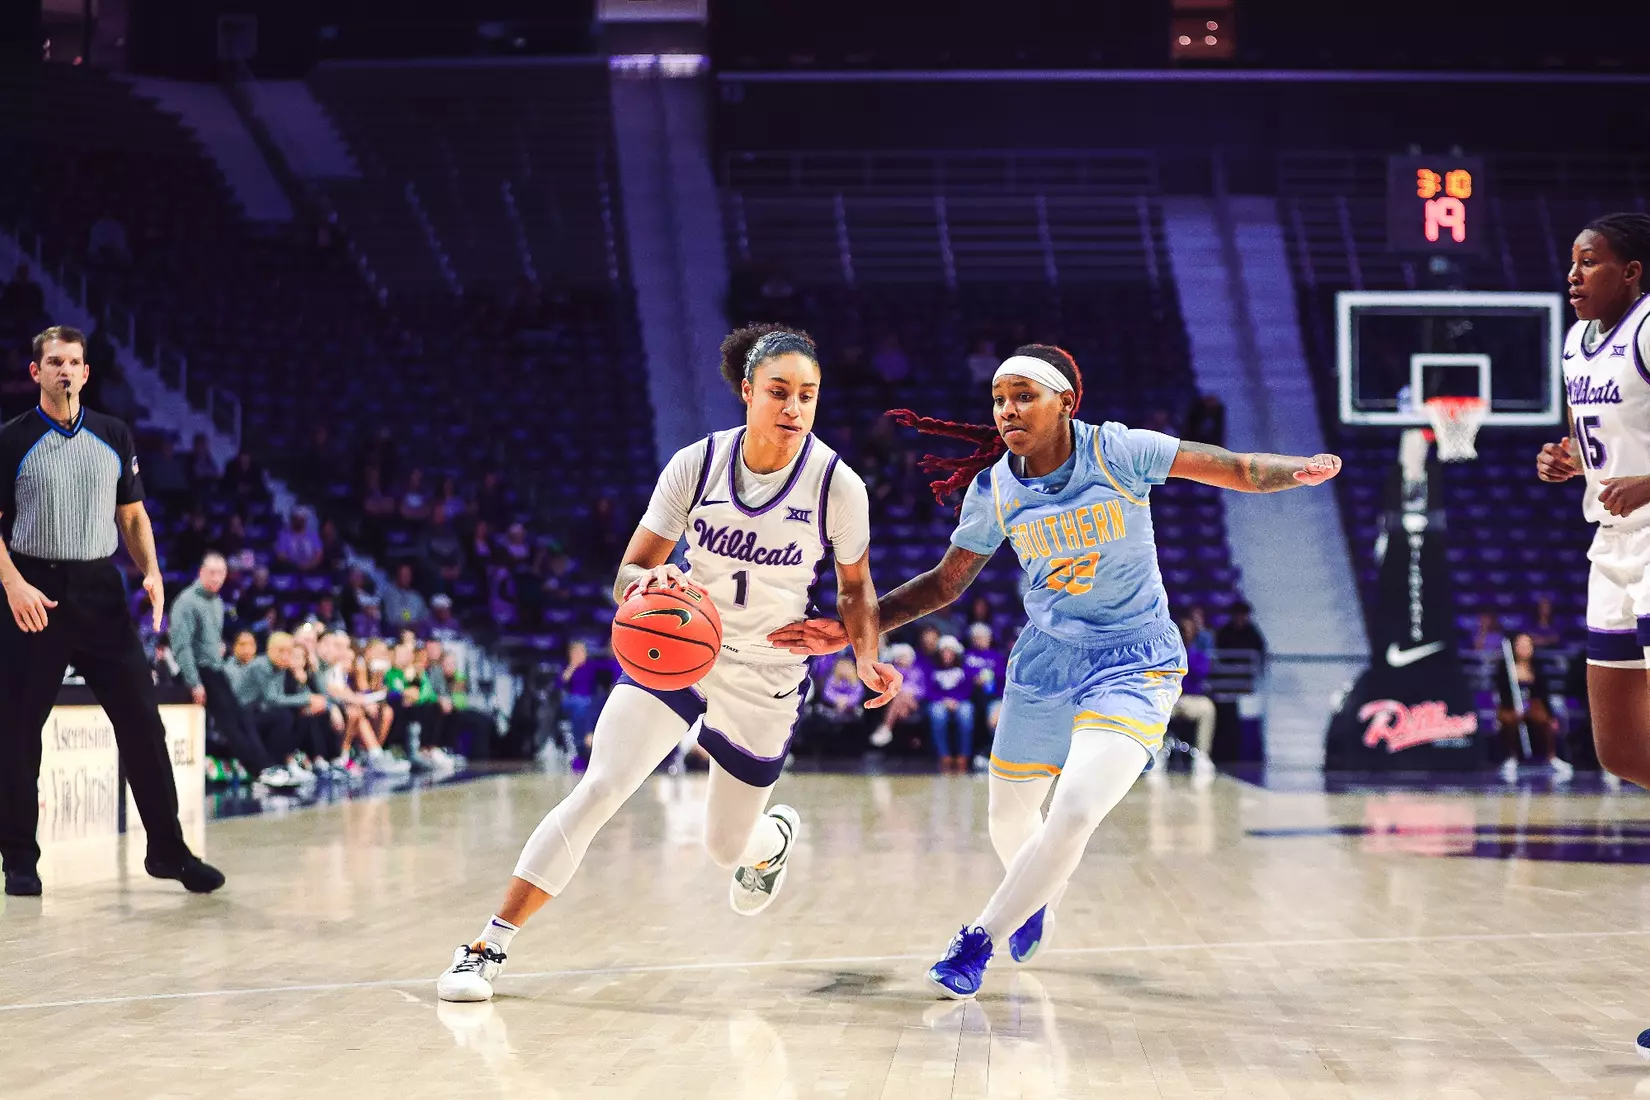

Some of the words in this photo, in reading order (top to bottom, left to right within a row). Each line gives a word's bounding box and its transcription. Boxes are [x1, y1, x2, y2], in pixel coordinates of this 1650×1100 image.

[1425, 196, 1466, 242] 19
[1576, 416, 1607, 469] 15
[785, 505, 812, 524] XII
[693, 518, 803, 566] Wildcats
[730, 570, 750, 609] 1
[53, 716, 112, 752] Ascension
